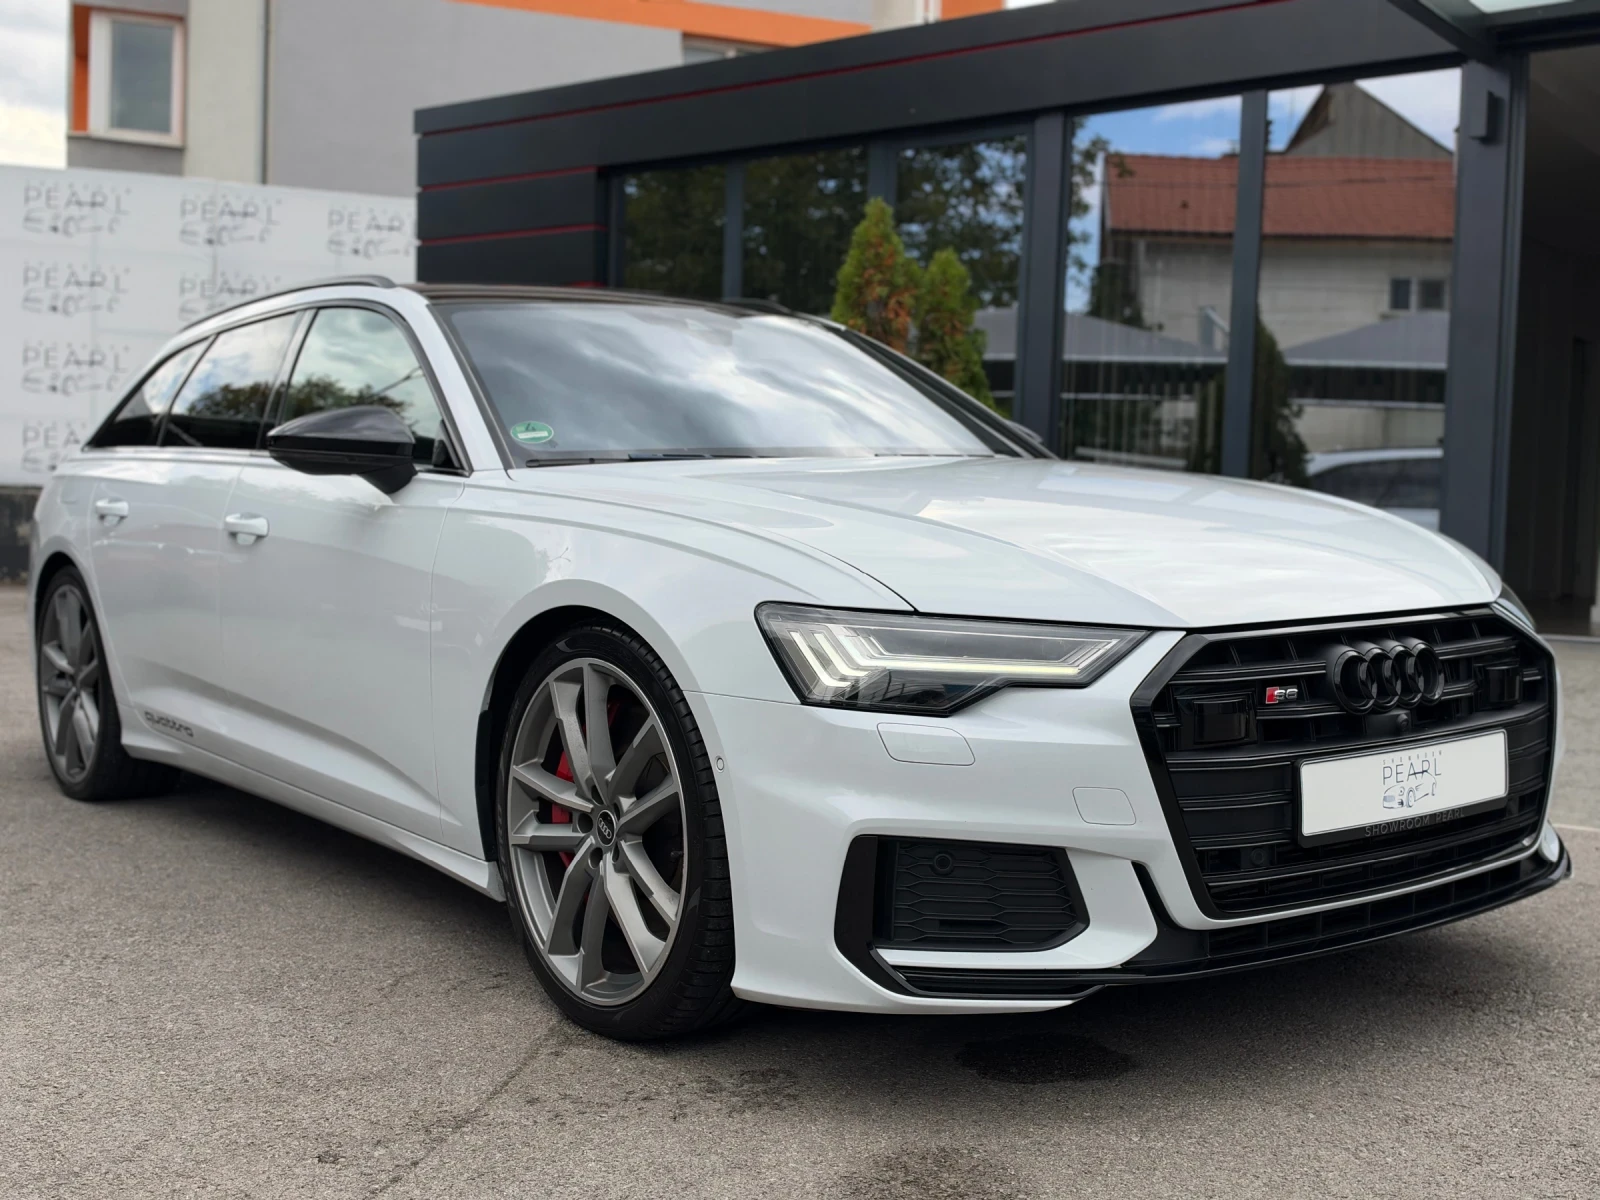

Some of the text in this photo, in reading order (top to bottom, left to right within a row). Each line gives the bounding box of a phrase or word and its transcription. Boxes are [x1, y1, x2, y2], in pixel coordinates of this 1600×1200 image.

[23, 185, 131, 216] PEARL
[180, 199, 281, 226] PEARL
[23, 265, 129, 294] PEARL
[22, 346, 128, 374] PEARL
[1382, 758, 1442, 786] PEARL
[1365, 808, 1465, 836] SHOWROOM PEARL
